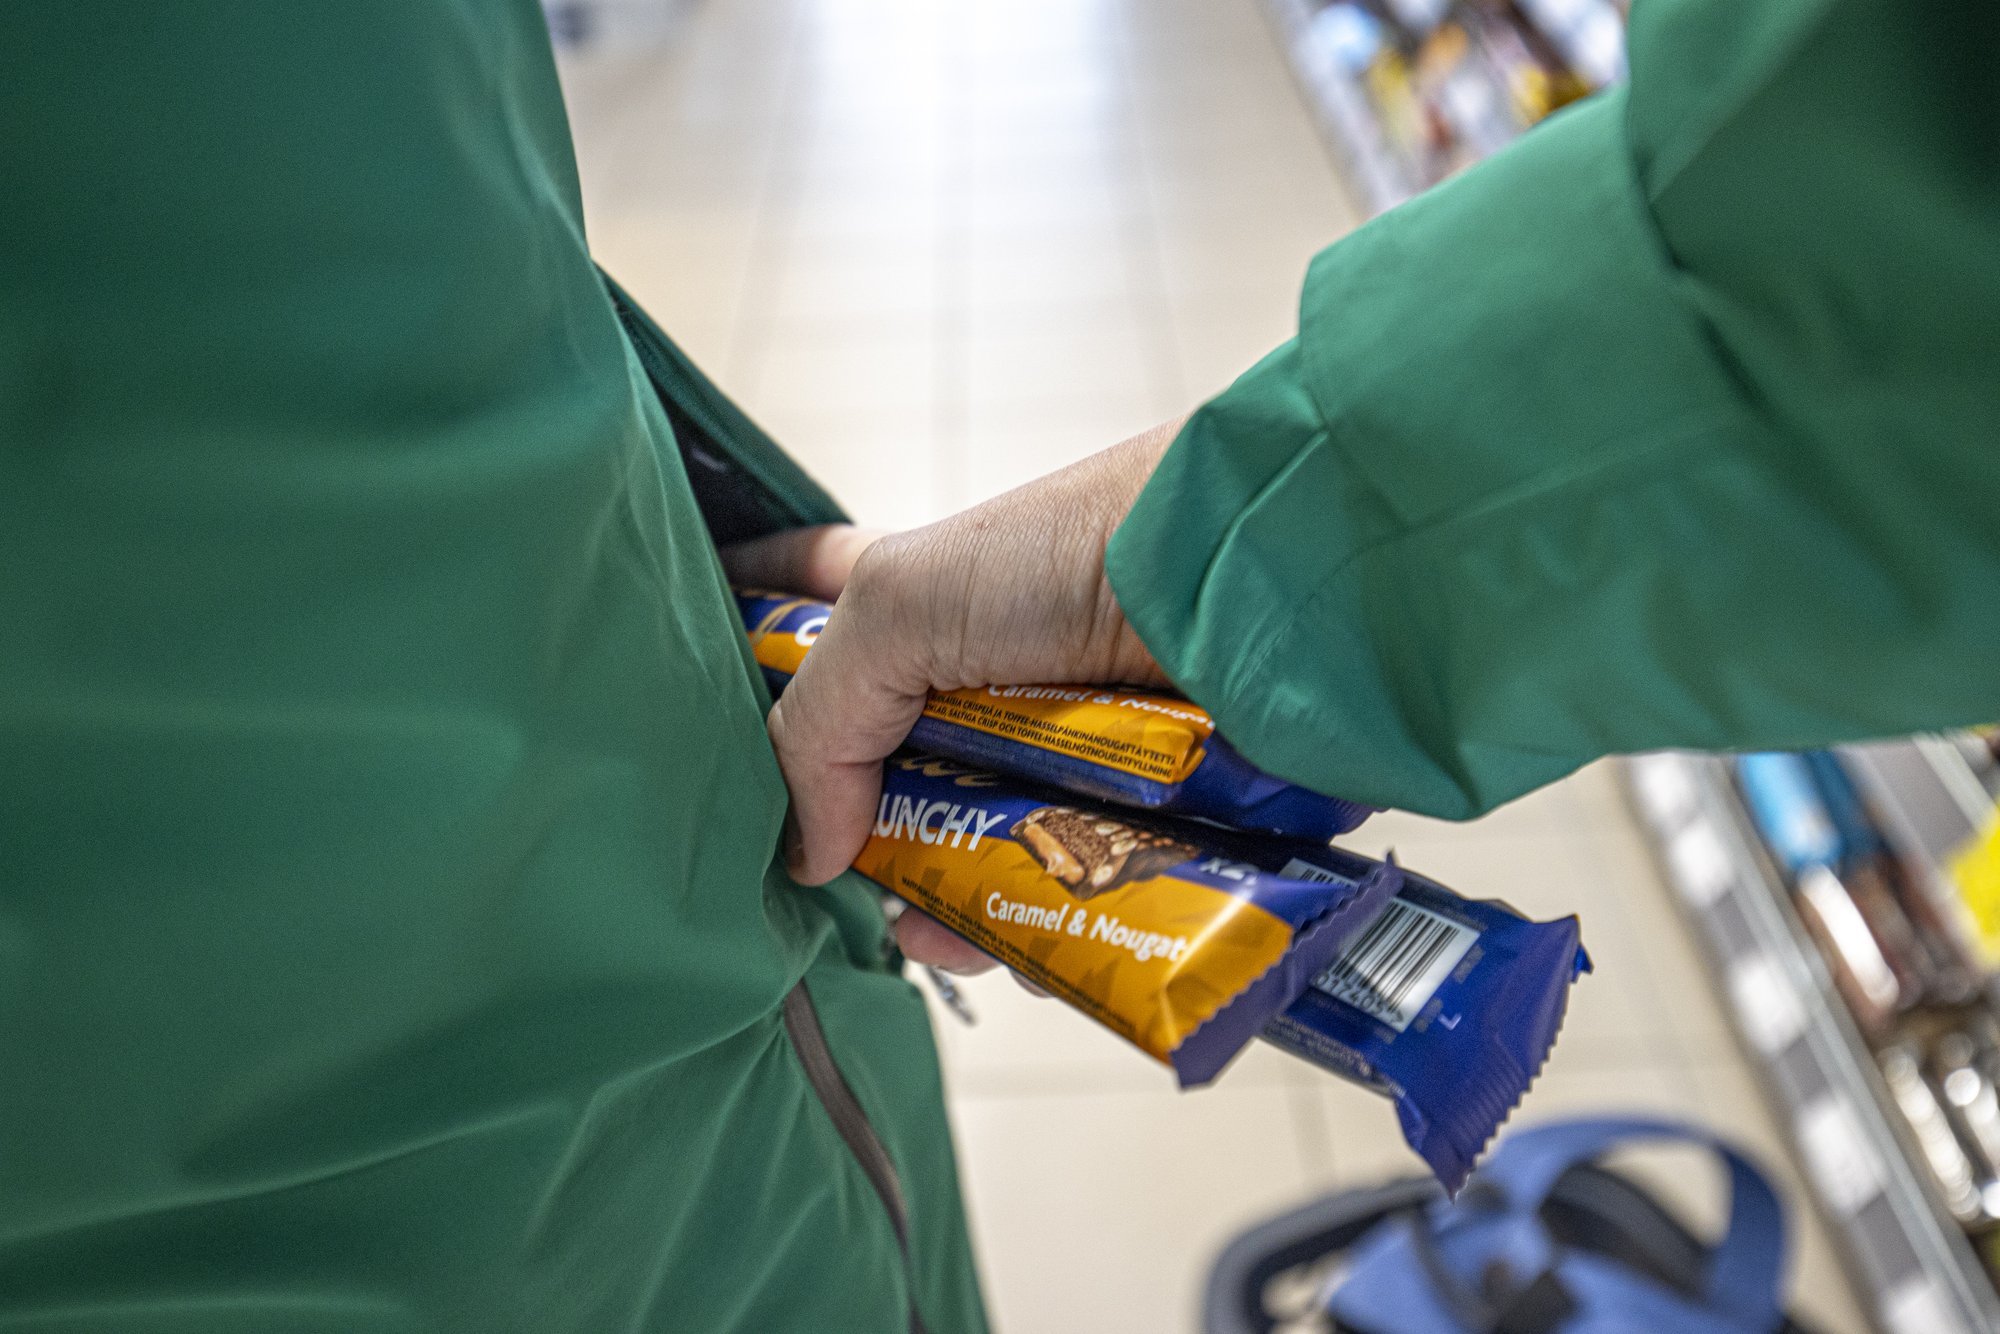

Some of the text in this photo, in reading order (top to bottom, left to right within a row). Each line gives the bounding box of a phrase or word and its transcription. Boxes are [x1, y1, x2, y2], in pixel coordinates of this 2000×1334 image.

[988, 685, 1093, 702] Caramel
[1093, 693, 1114, 705] &
[999, 723, 1016, 734] OCH
[872, 793, 1008, 851] UNCHY
[986, 891, 1070, 932] Caramel
[1067, 908, 1088, 937] &
[1089, 913, 1190, 962] Nougat
